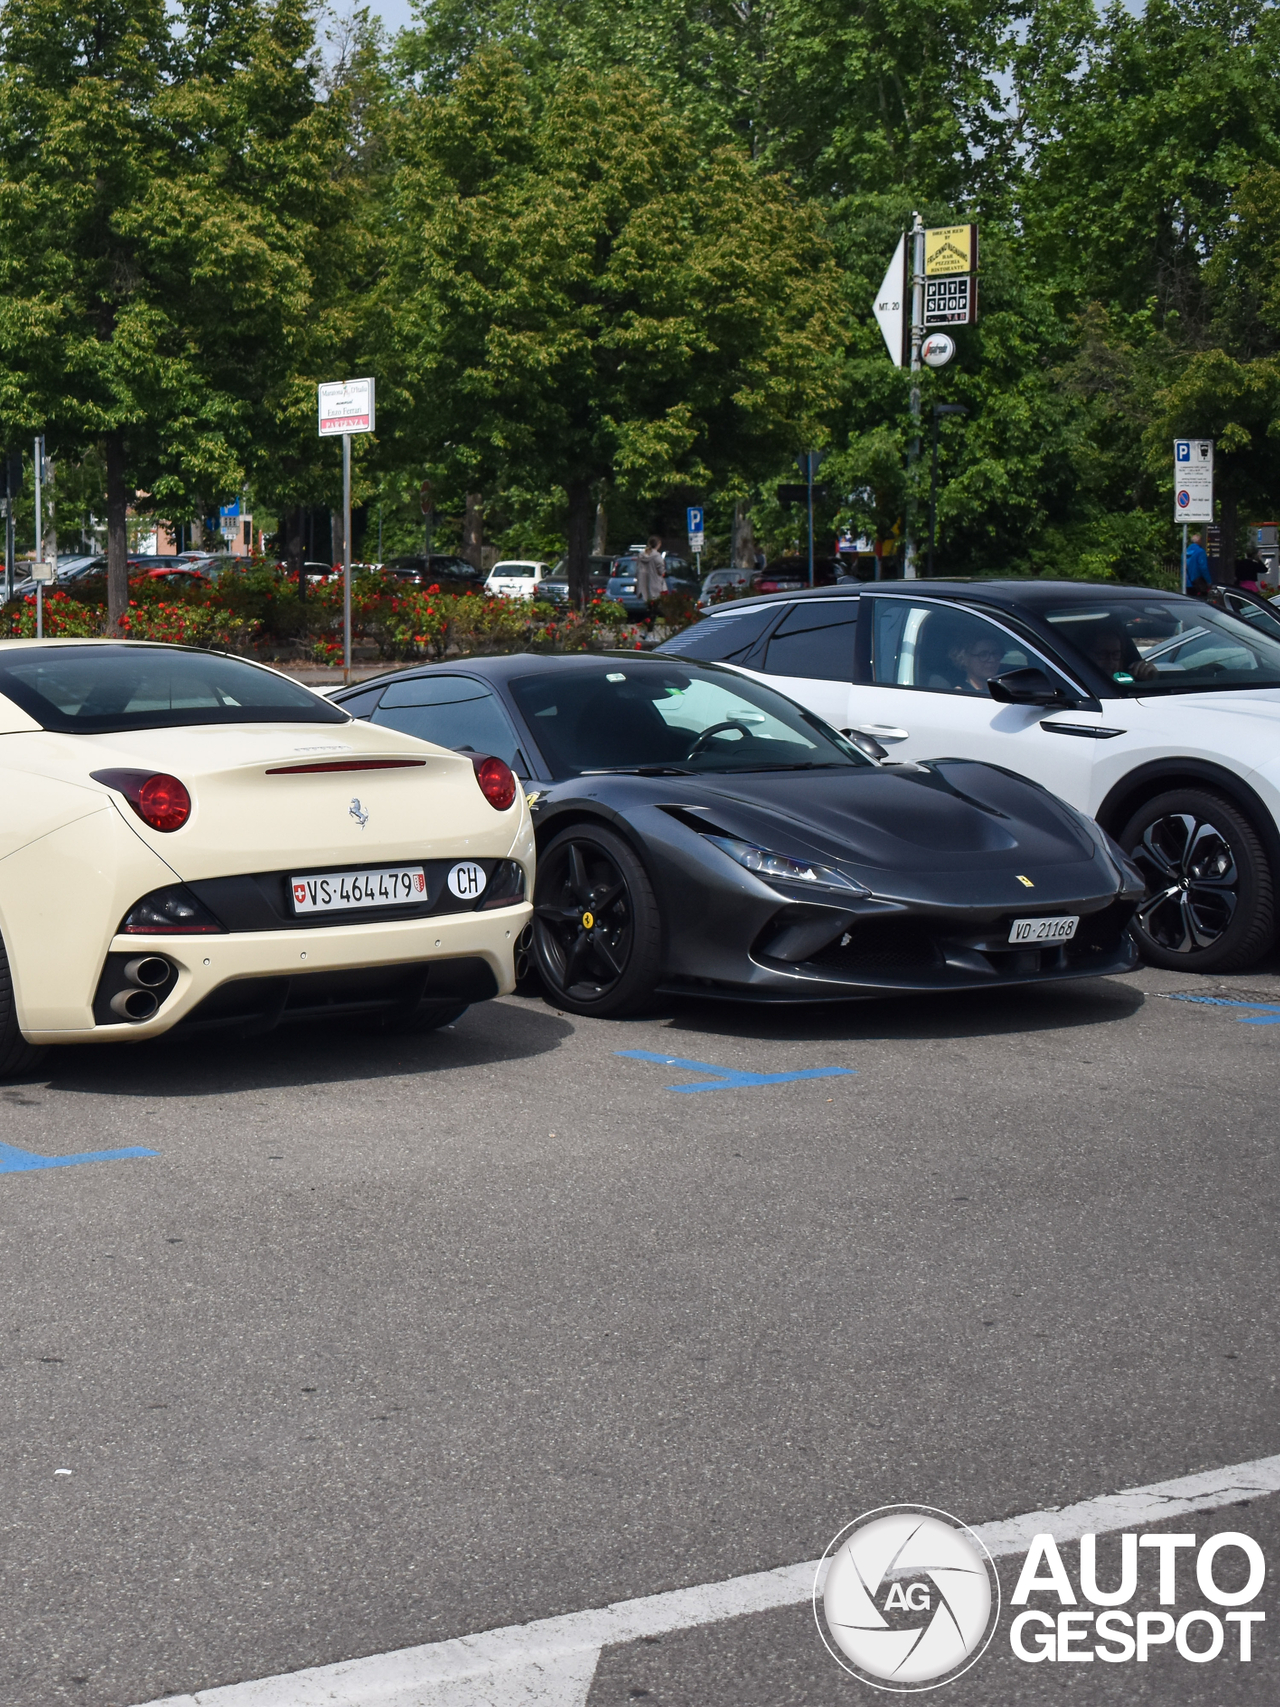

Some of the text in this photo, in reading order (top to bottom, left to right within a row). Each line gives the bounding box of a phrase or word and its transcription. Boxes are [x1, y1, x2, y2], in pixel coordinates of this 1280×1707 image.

[928, 282, 966, 296] PIT-
[879, 302, 900, 311] MT. 20
[928, 298, 966, 310] STOP
[328, 408, 342, 416] Enzo
[326, 419, 364, 428] PARTENZA
[1180, 446, 1188, 460] P
[691, 510, 700, 530] P
[456, 867, 478, 895] CH
